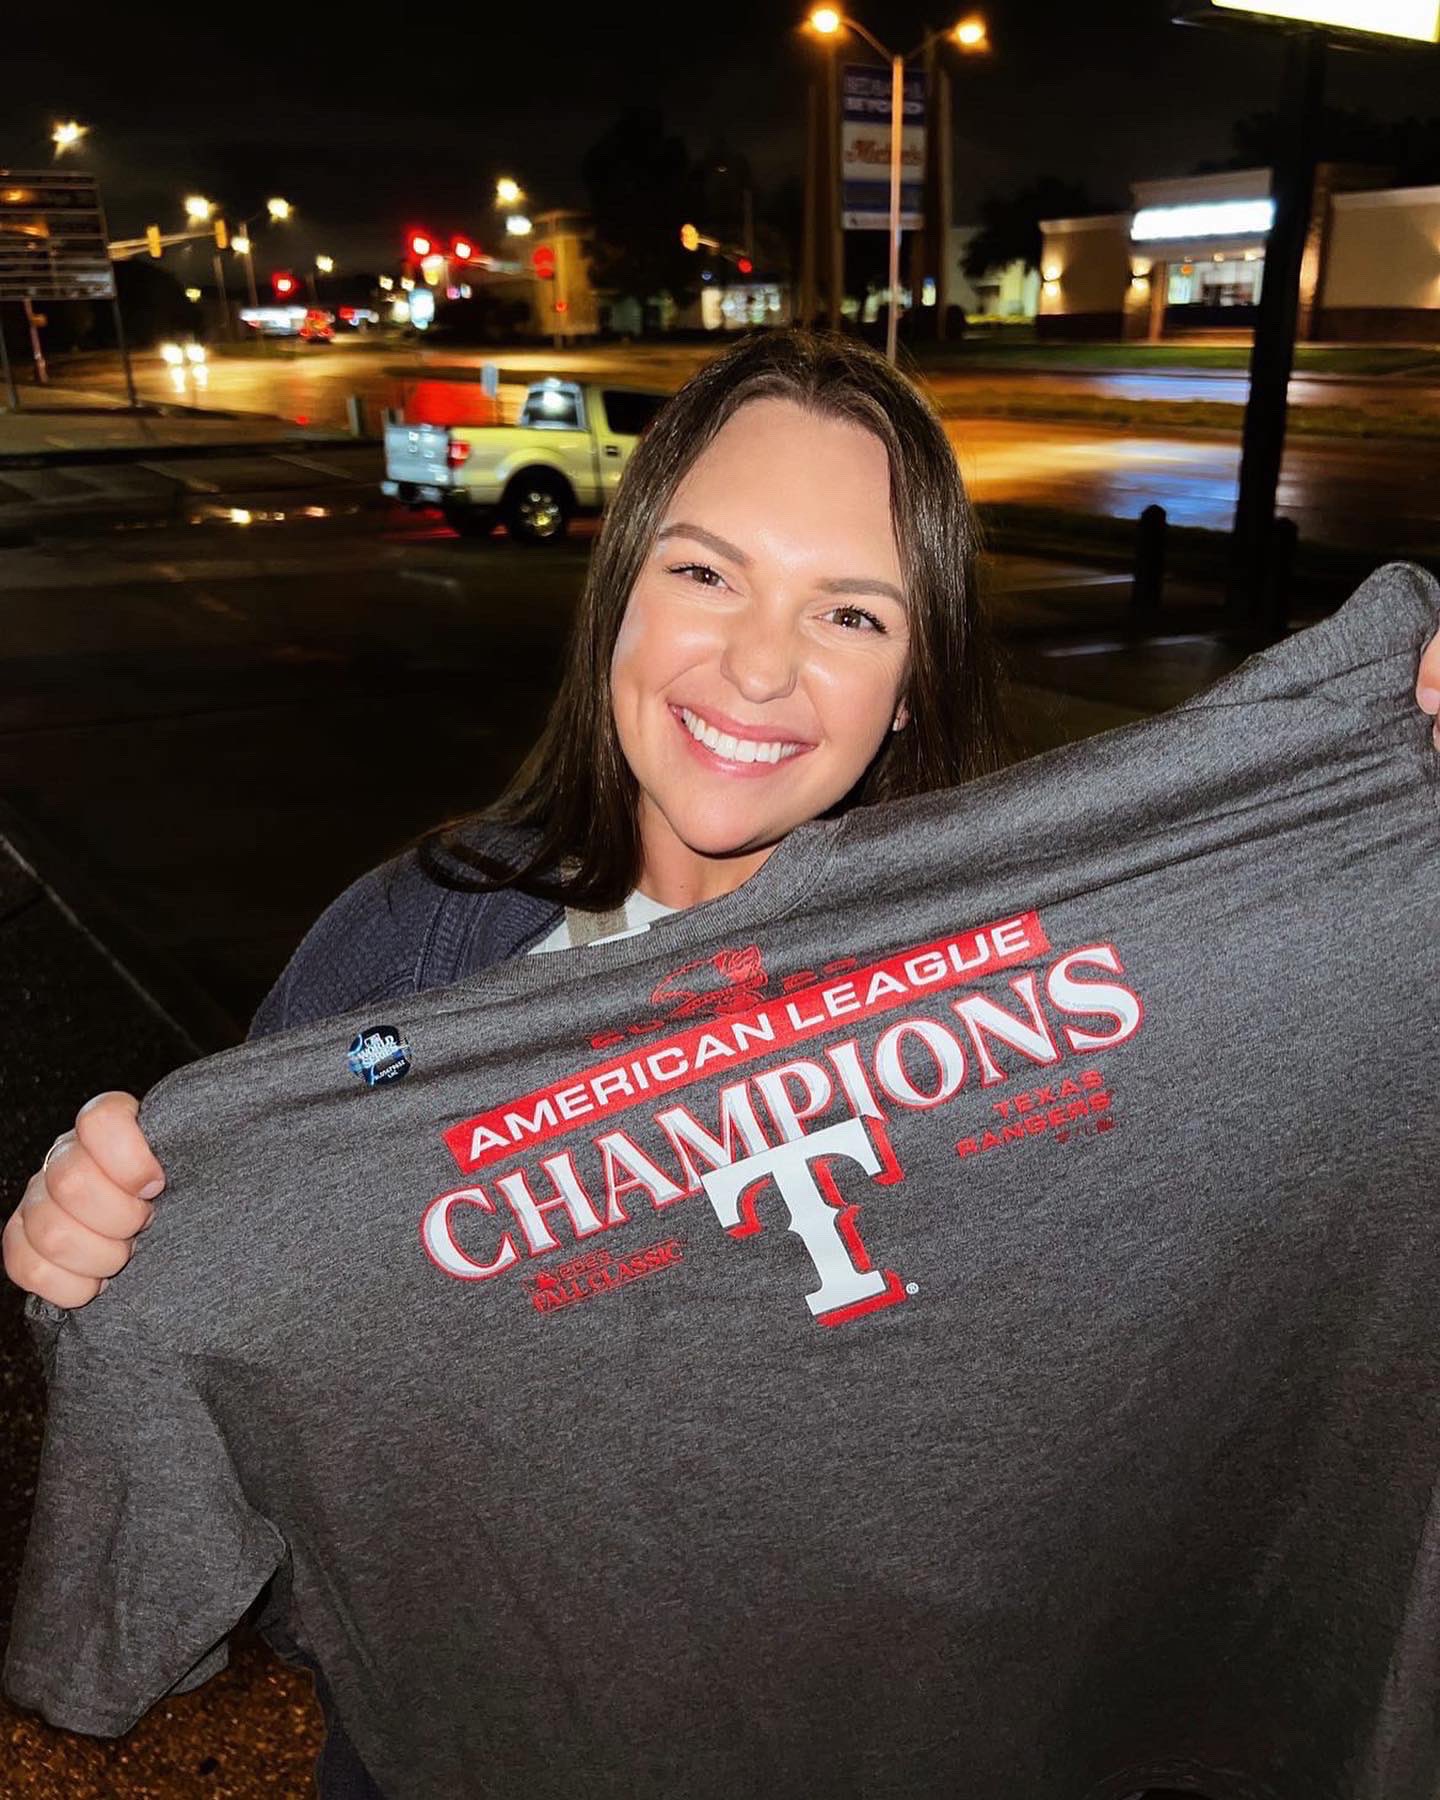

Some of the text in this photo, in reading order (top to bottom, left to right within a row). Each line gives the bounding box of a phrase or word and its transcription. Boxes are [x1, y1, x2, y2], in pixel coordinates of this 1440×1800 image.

[420, 942, 1145, 1282] CHAMPIONS
[469, 919, 1032, 1161] AMERICAN LEAGUE
[954, 1091, 1112, 1160] RANGERS
[993, 1070, 1104, 1119] TEXAS
[700, 1114, 906, 1328] T
